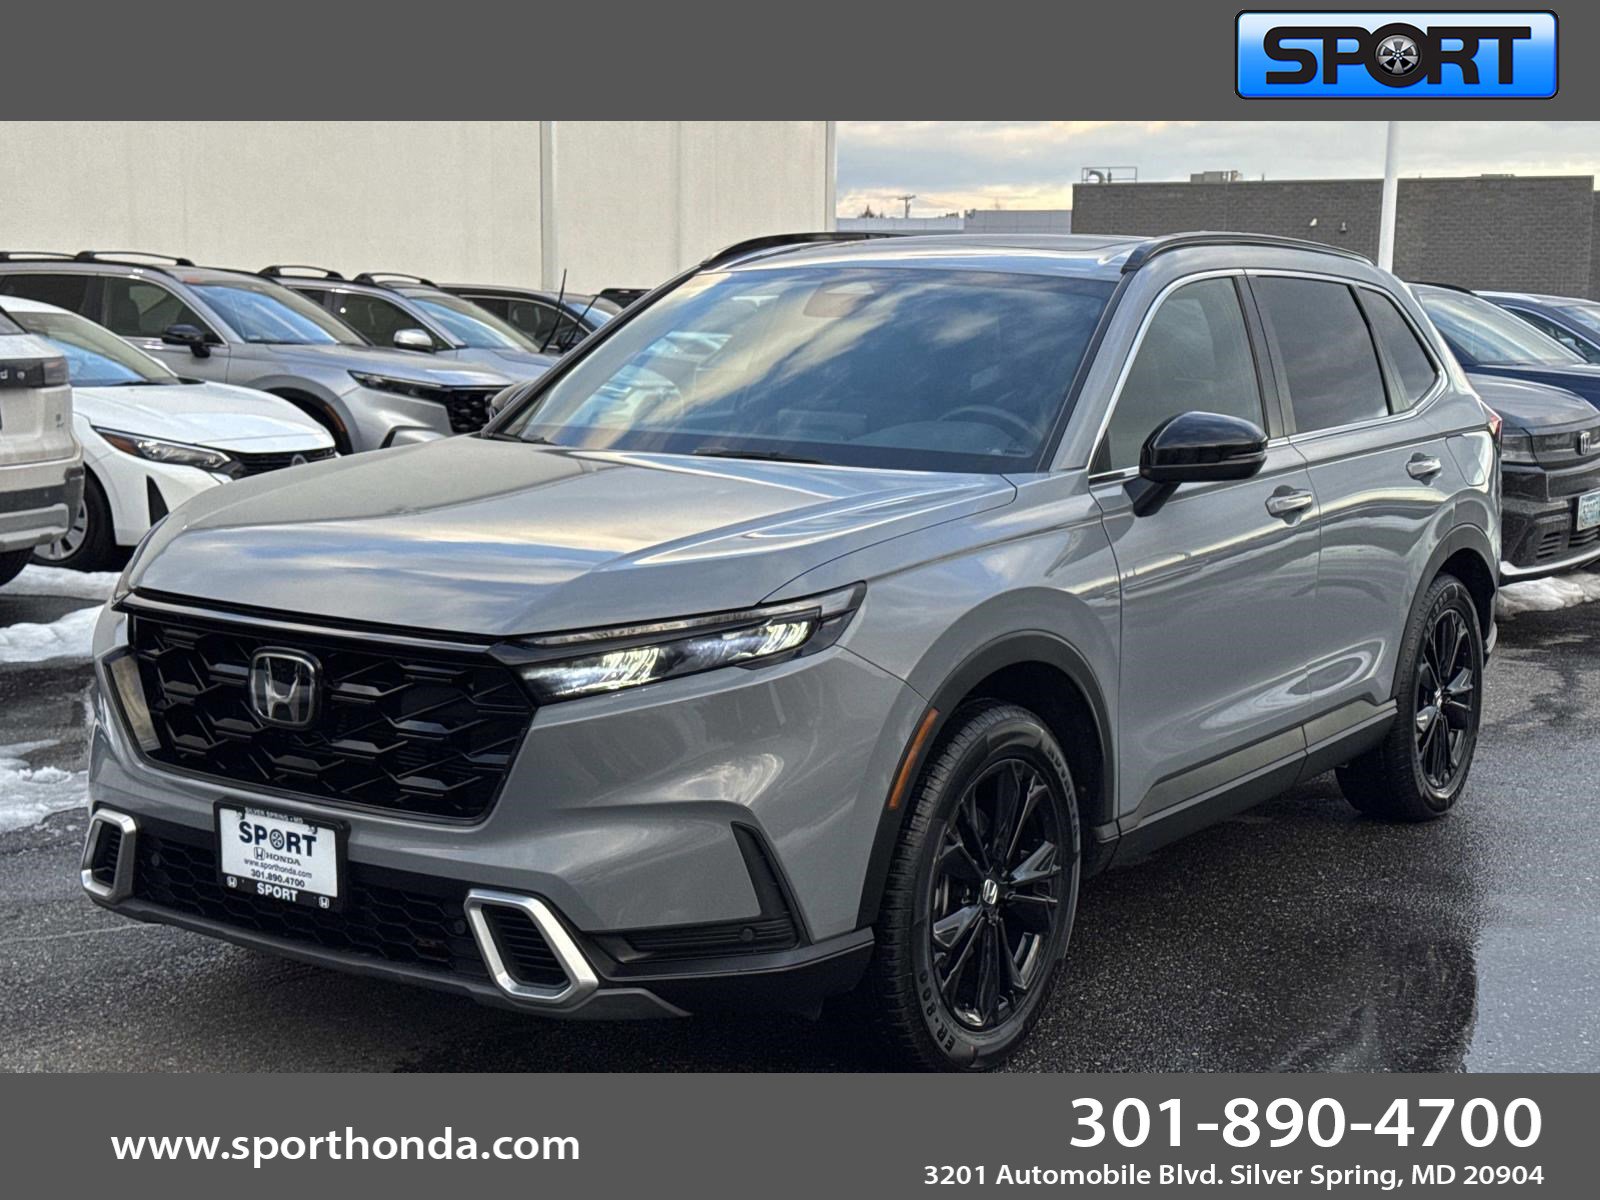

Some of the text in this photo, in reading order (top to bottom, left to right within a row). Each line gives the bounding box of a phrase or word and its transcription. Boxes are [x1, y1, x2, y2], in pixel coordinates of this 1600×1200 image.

[238, 821, 317, 857] SPORT
[244, 858, 312, 879] www.sporthonda.com
[266, 852, 301, 866] HONDA
[257, 882, 298, 902] SPORT
